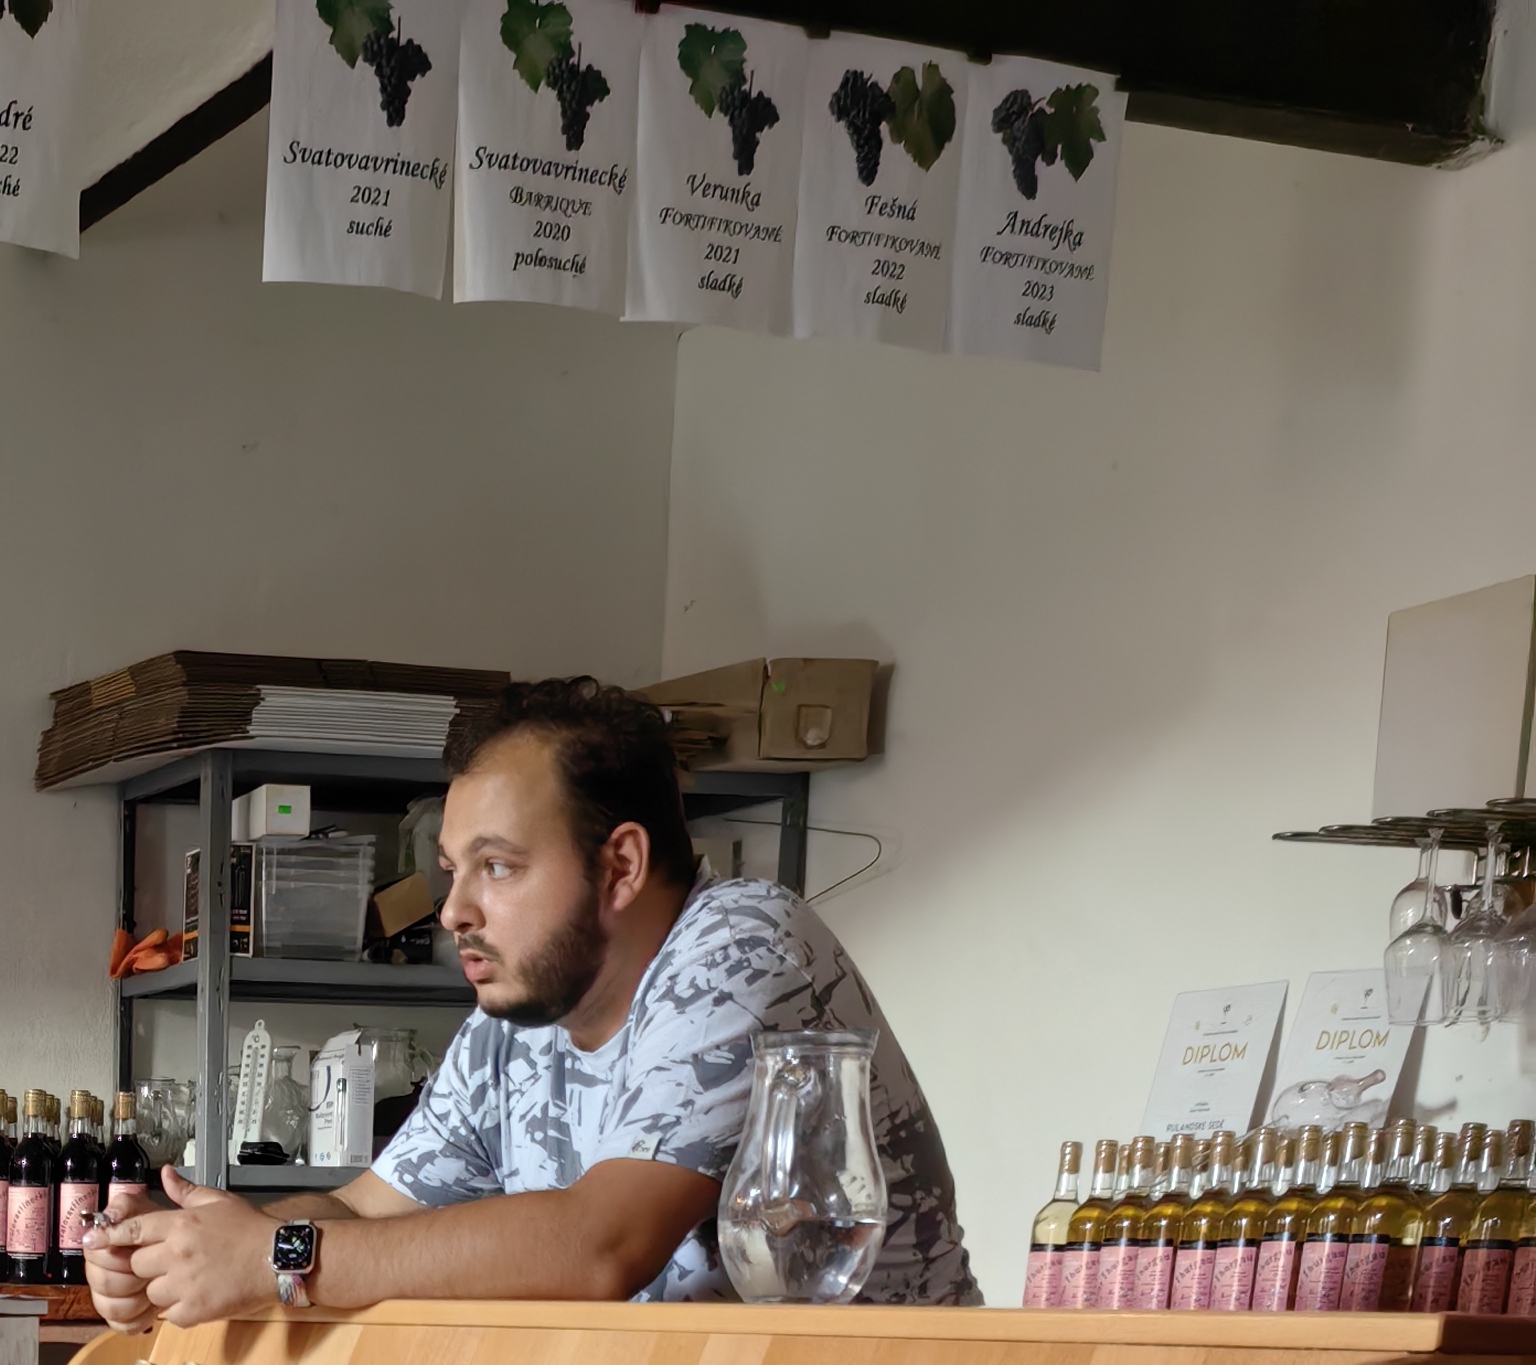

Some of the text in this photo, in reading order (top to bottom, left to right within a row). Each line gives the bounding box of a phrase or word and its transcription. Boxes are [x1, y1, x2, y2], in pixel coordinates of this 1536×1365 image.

[350, 185, 391, 207] 2021
[686, 172, 762, 212] Verunka
[864, 195, 918, 221] Fešná
[346, 216, 393, 238] suché
[533, 221, 571, 242] 2020
[996, 210, 1085, 252] Andrejka
[512, 248, 587, 277] polosuché
[704, 243, 740, 264] 2021
[871, 259, 905, 280] 2022
[697, 270, 744, 299] sladké
[1022, 280, 1054, 301] 2023
[864, 285, 908, 314] sladké
[1014, 306, 1058, 335] sladké
[1315, 1028, 1391, 1050] DIPLOM
[1182, 1041, 1249, 1065] DIPLOM
